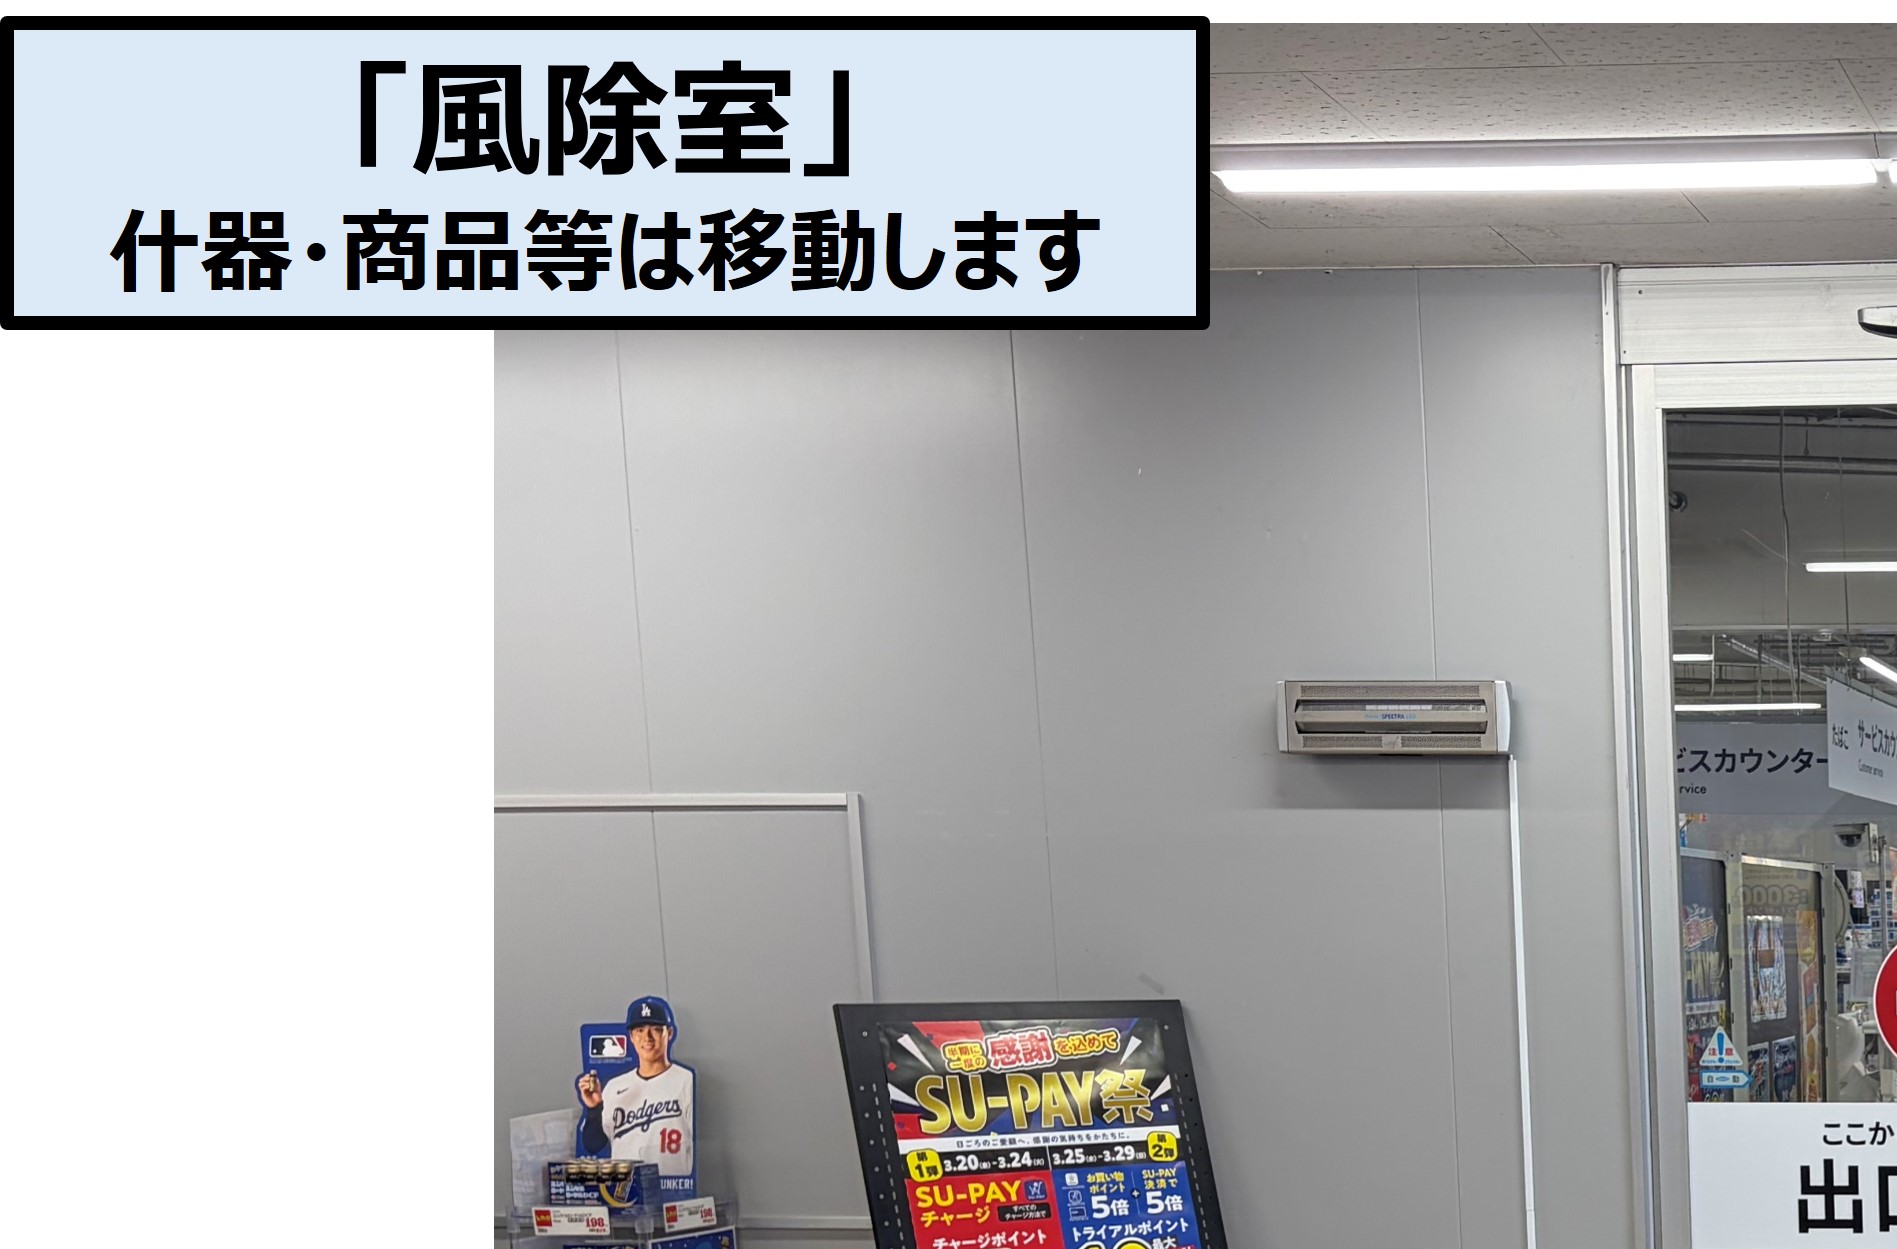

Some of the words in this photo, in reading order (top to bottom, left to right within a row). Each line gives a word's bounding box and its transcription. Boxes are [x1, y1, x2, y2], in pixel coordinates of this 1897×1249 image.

[1679, 784, 1708, 795] rvice
[986, 1030, 1053, 1068] 感謝
[1055, 1032, 1118, 1055] を込めて
[915, 1068, 1154, 1134] SU-PAY祭
[613, 1099, 682, 1134] Dodgers
[660, 1128, 681, 1154] 18
[1086, 1172, 1125, 1184] お買い物
[1142, 1168, 1177, 1179] SU-PAY
[916, 1180, 1021, 1208] SU-PAY
[1089, 1182, 1126, 1194] ポイント
[1092, 1196, 1130, 1219] 5倍
[1146, 1192, 1184, 1215] 5倍
[921, 1207, 990, 1228] チャージ
[1072, 1218, 1188, 1242] トライアルポイント
